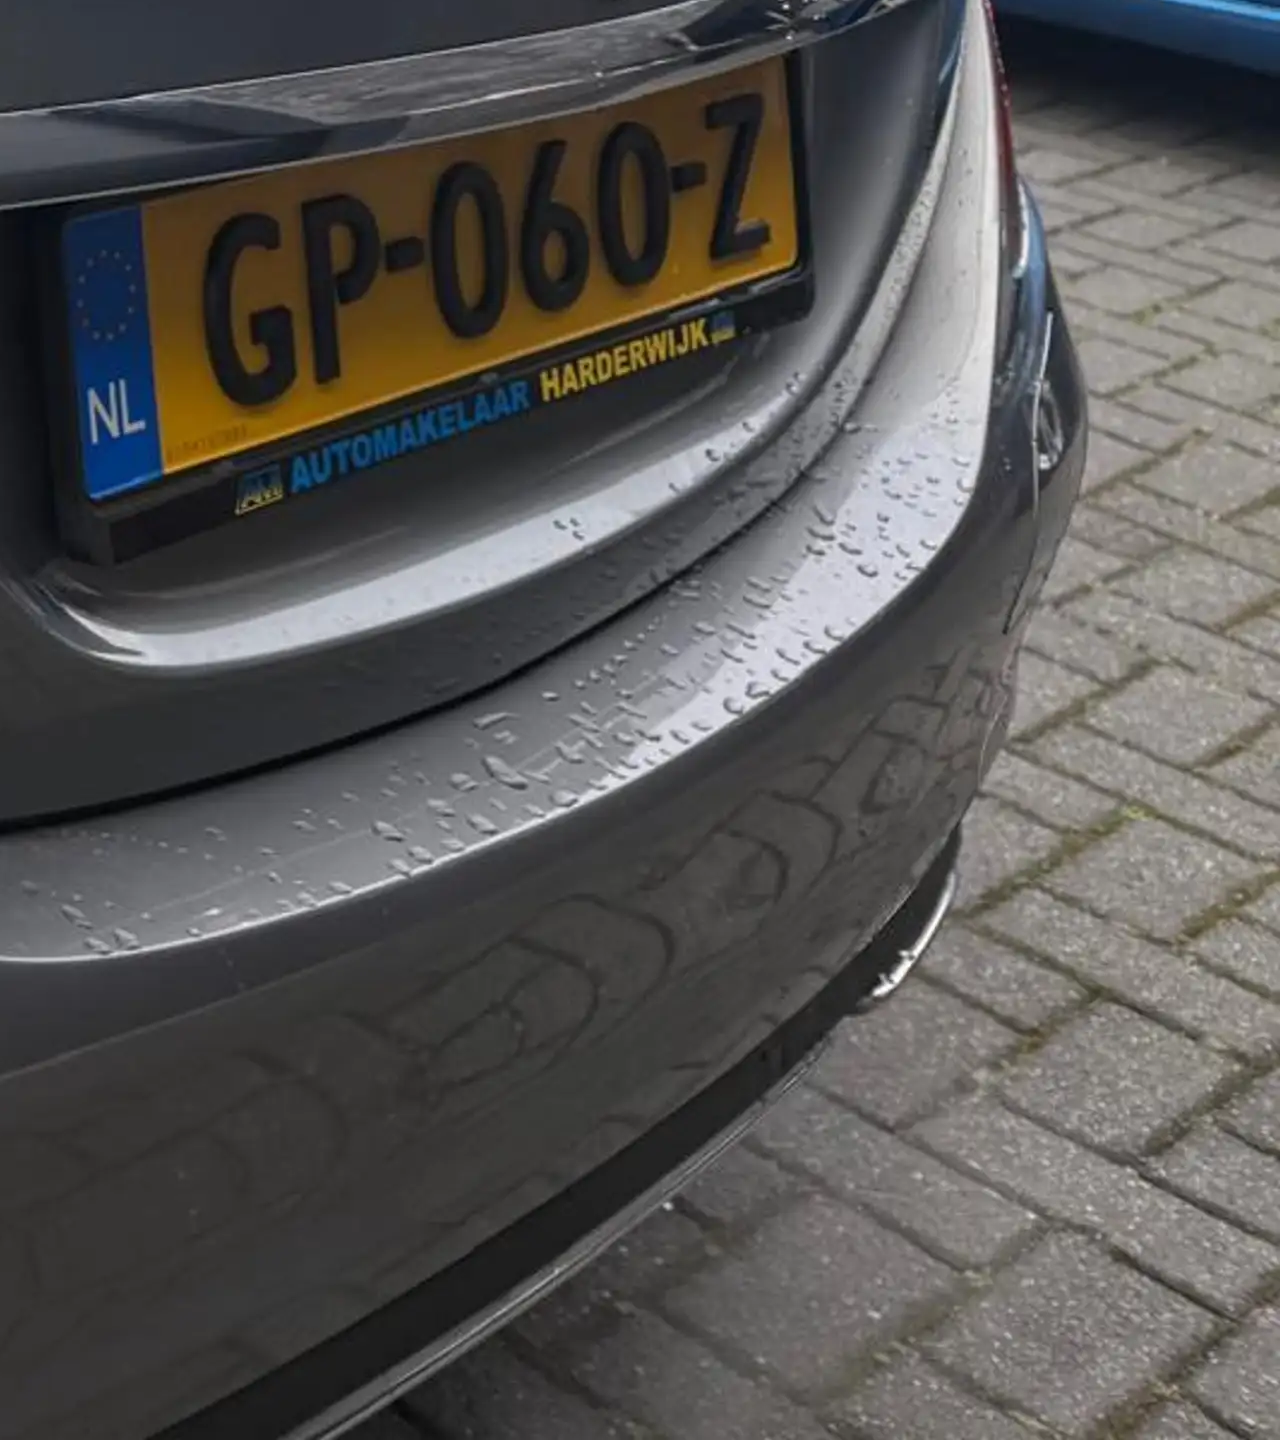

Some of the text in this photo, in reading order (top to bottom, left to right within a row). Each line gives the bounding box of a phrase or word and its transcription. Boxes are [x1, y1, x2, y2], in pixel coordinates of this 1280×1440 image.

[202, 92, 772, 408] GP-060-Z
[86, 379, 146, 445] NL
[291, 380, 531, 493] AUTOMAKELAAR
[540, 317, 709, 402] HARDERWIJK
